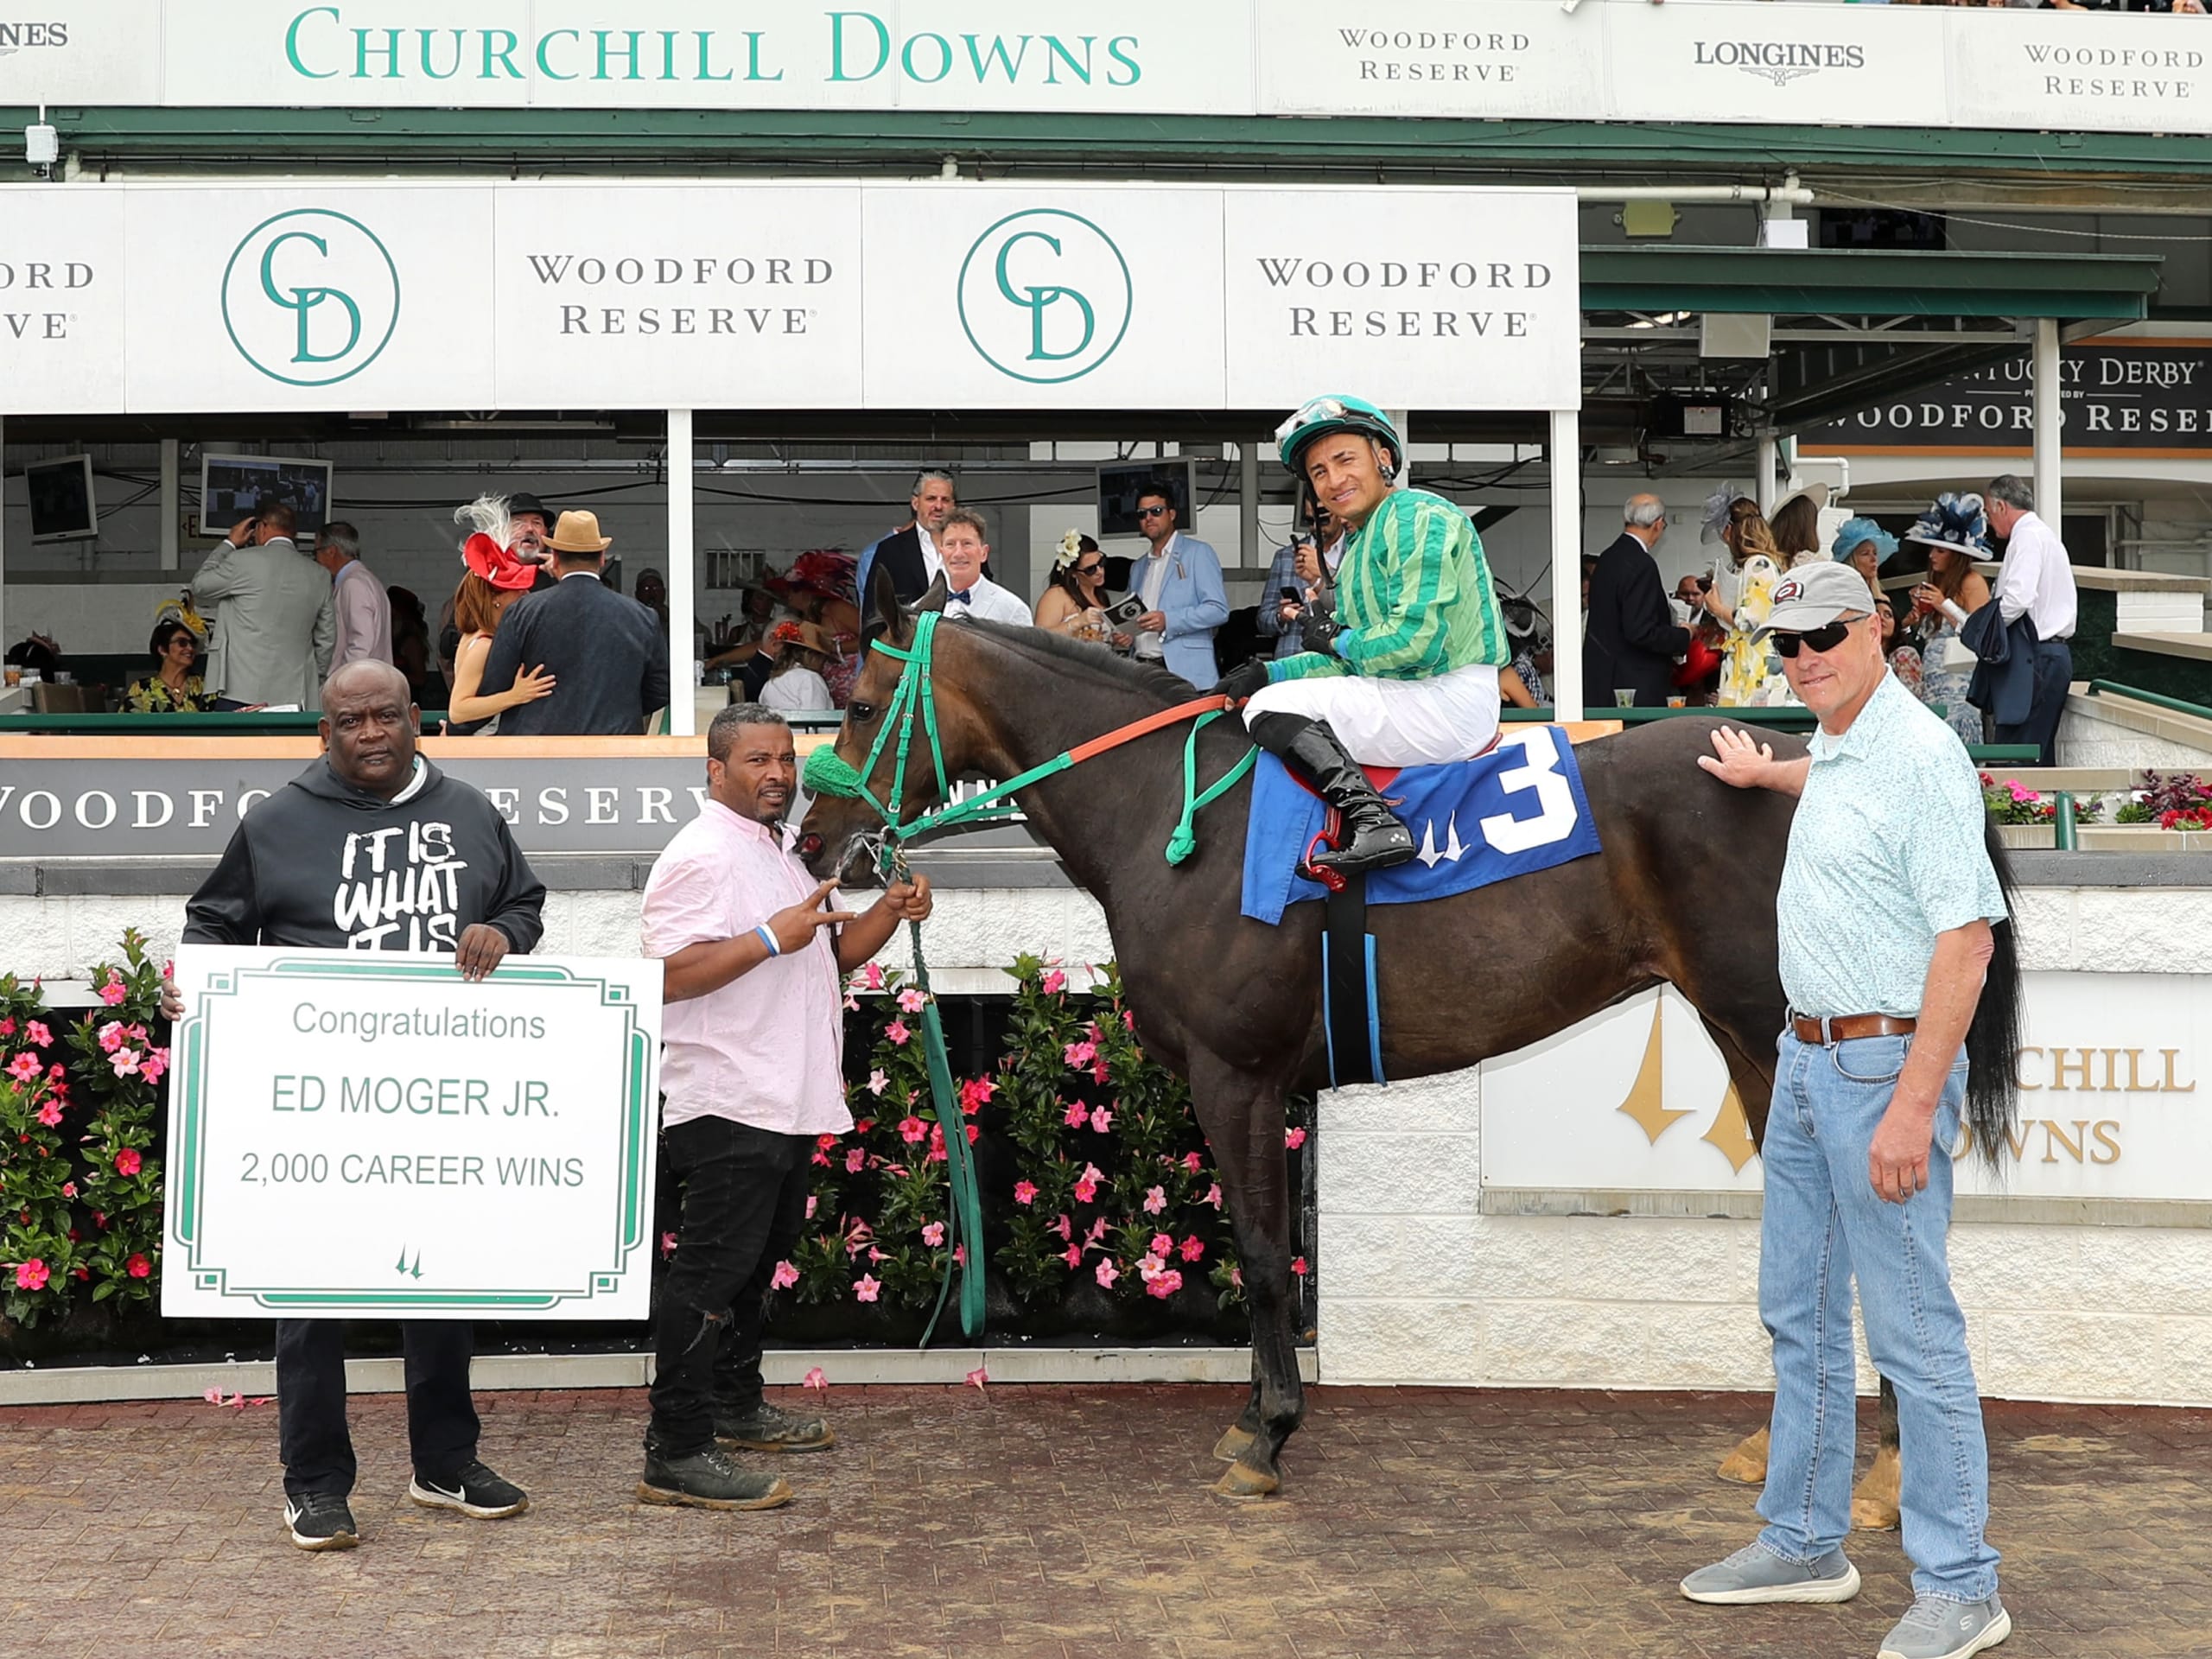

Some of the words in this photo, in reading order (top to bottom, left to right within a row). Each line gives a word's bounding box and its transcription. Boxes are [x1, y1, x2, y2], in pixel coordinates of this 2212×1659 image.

[286, 7, 784, 82] CHURCHILL
[825, 12, 1143, 86] DOWNS
[1340, 29, 1530, 52] WOODFORD
[1694, 41, 1865, 68] LONGINES
[2025, 44, 2205, 67] WOODFORD
[1361, 60, 1514, 82] RESERVE
[2045, 77, 2190, 98] RESERVE
[527, 256, 834, 285] WOODFORD
[1258, 258, 1552, 289] WOODFORD
[560, 305, 808, 335] RESERVE
[1290, 308, 1529, 338] RESERVE
[2100, 358, 2196, 389] DERBY
[1828, 404, 2066, 430] OODFOR
[1468, 726, 1578, 855] 3
[342, 827, 404, 880] IT
[409, 821, 455, 863] IS
[334, 861, 468, 931] WHAT
[293, 1001, 546, 1043] Congratulations
[272, 1076, 327, 1112] ED
[341, 1077, 491, 1116] MOGER
[504, 1081, 559, 1117] JR.
[240, 1153, 329, 1186] 2,000
[341, 1154, 485, 1185] CAREER
[497, 1158, 585, 1188] WINS
